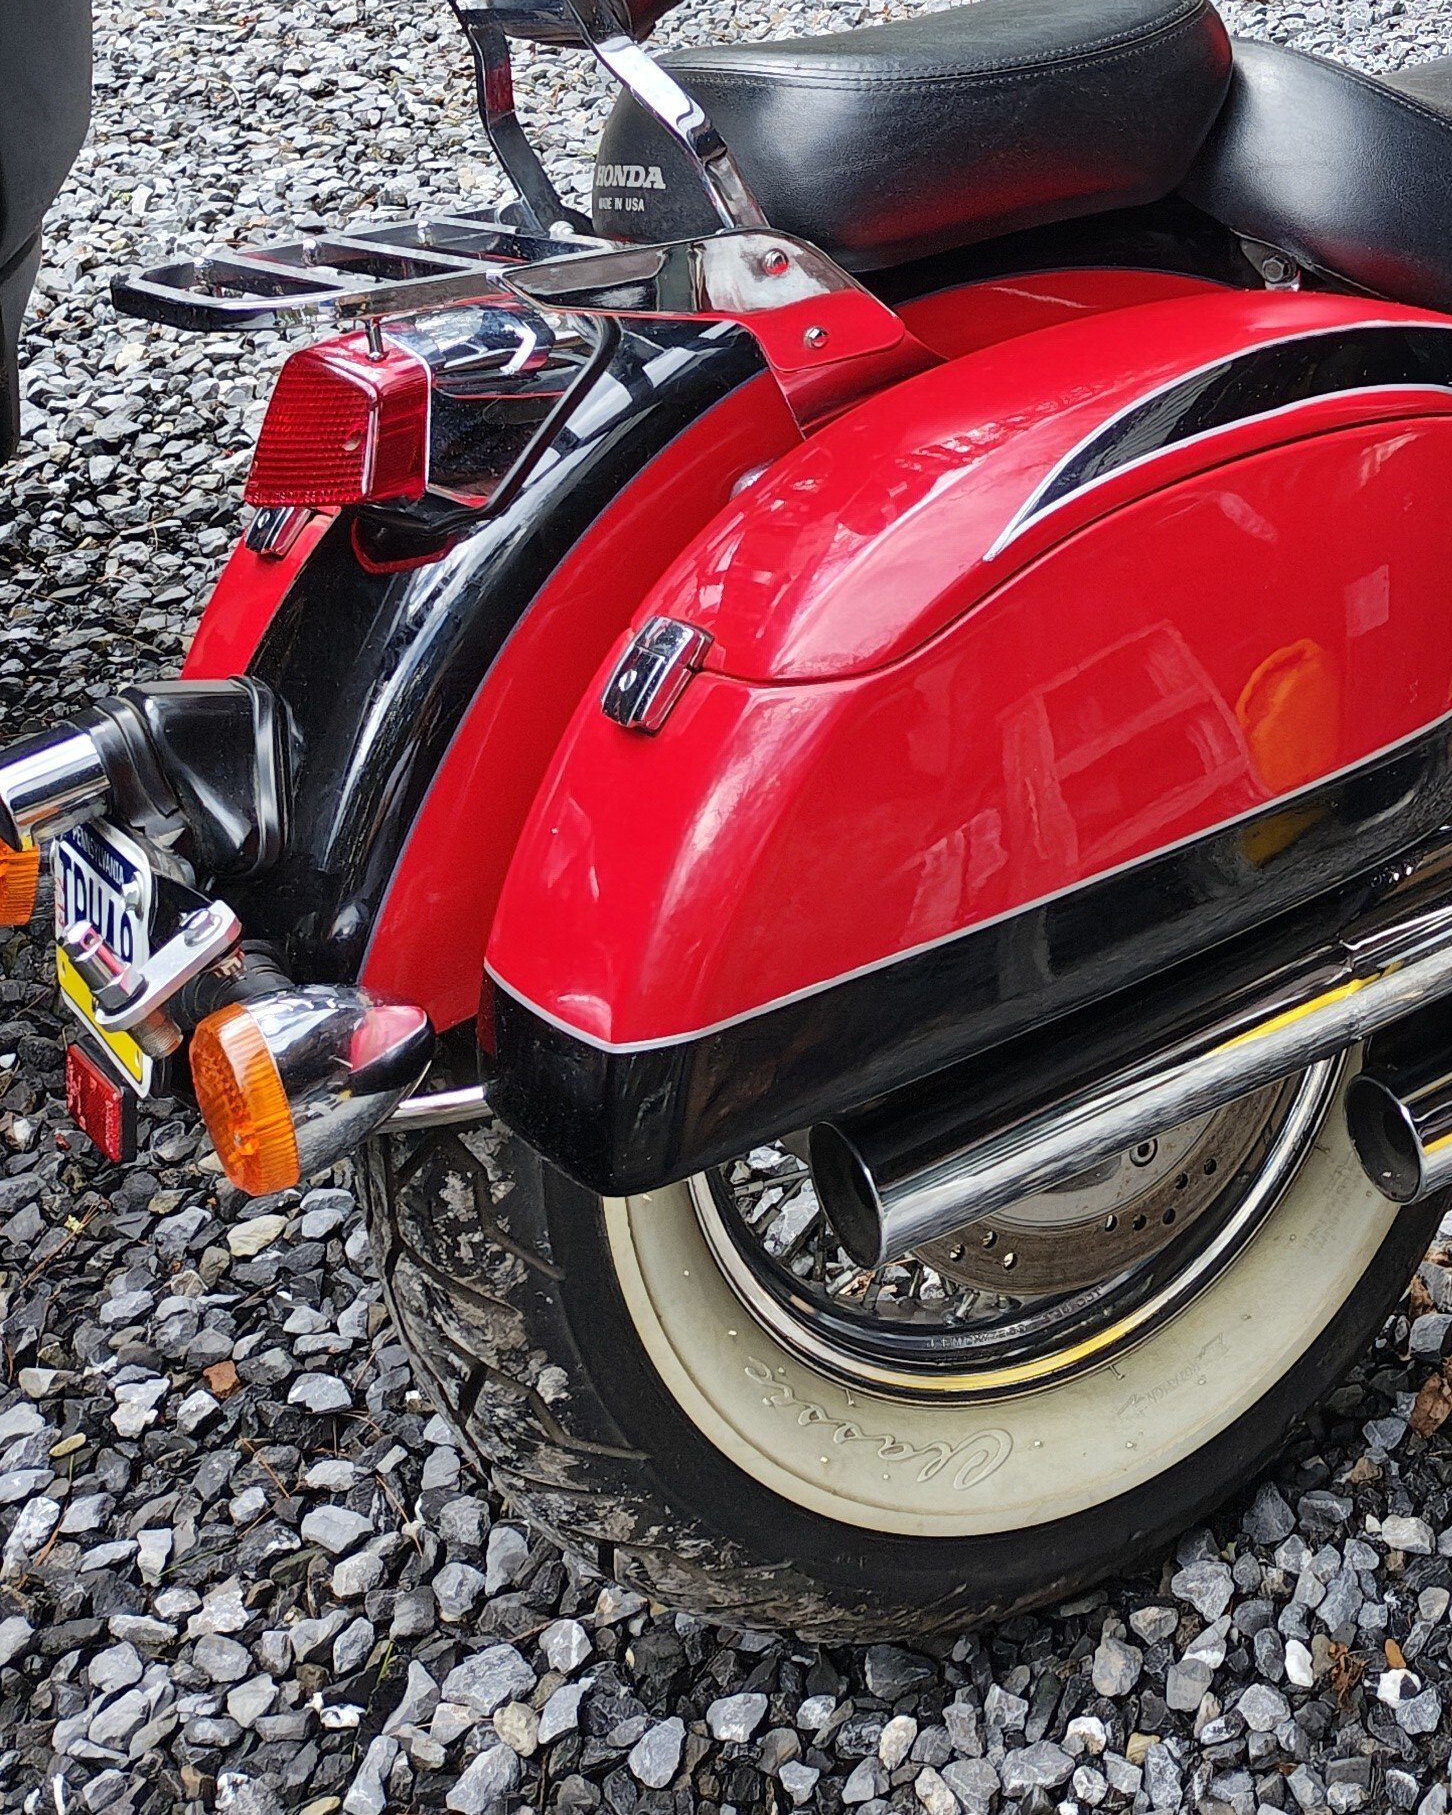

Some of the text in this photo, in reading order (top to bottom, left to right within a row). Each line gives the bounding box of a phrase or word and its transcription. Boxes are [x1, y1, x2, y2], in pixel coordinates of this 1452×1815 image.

[595, 164, 667, 190] HONDA
[614, 197, 623, 211] IN
[625, 197, 645, 212] USA
[744, 1355, 1014, 1490] Classic
